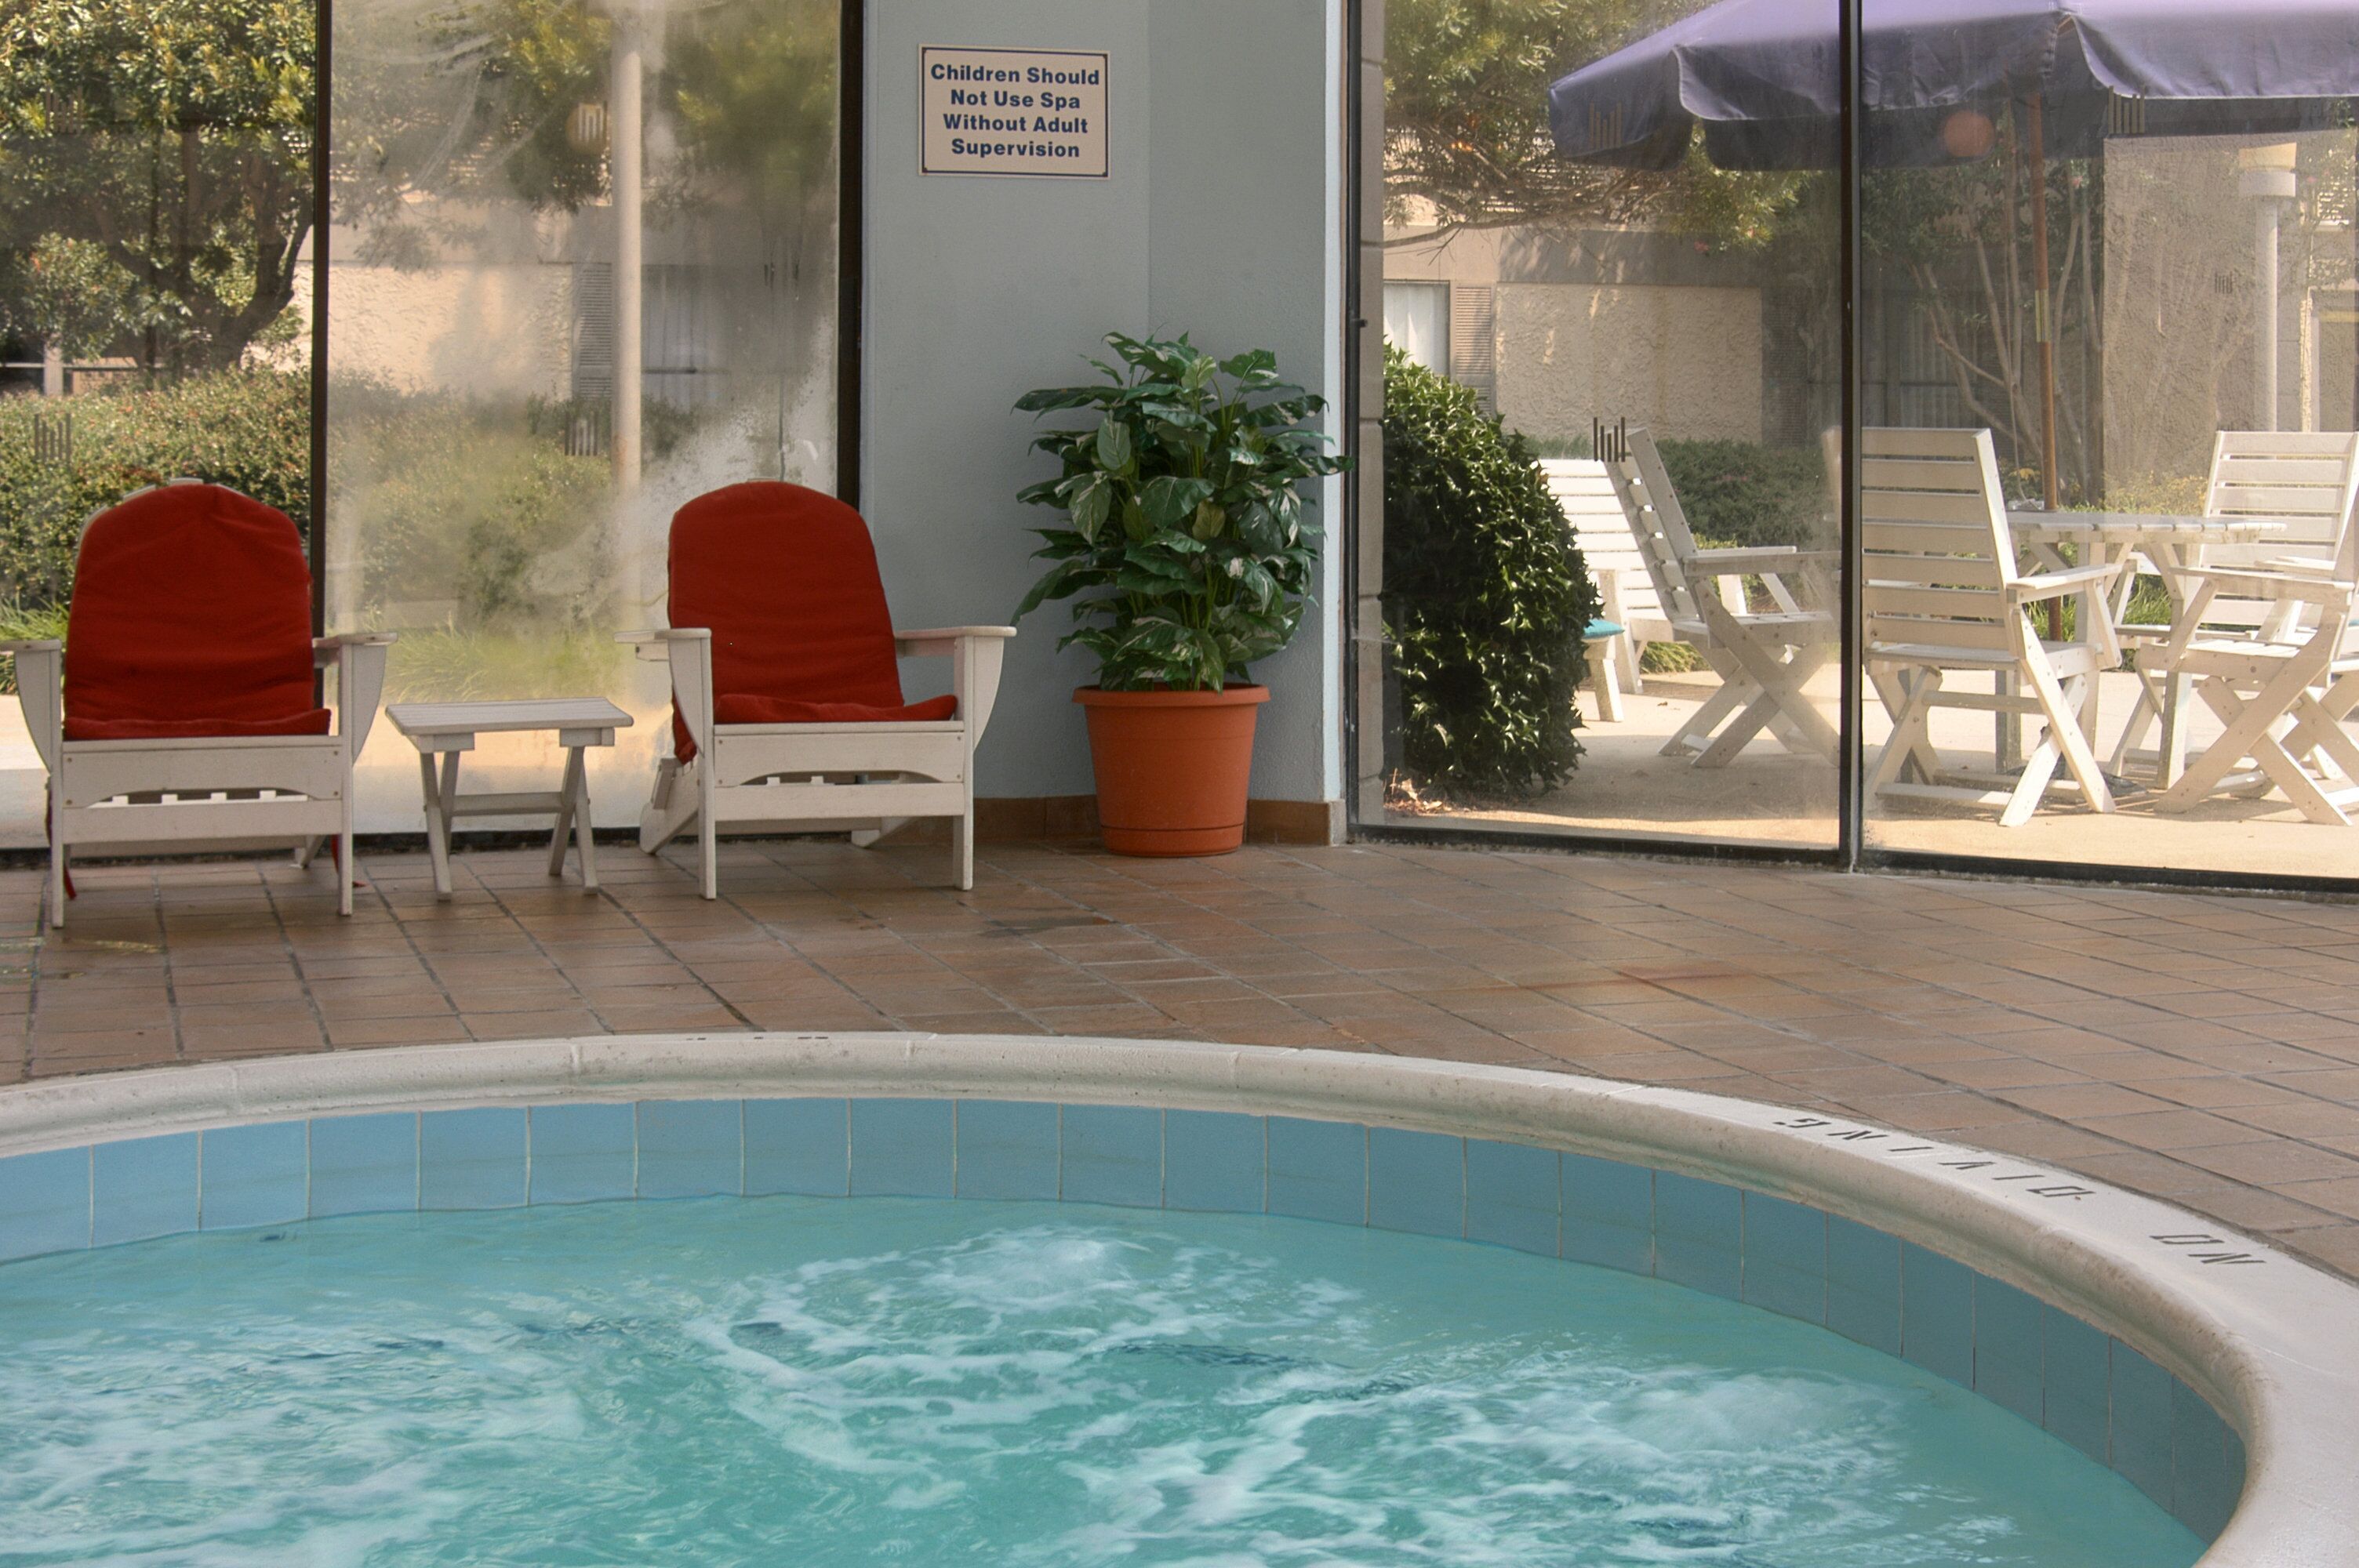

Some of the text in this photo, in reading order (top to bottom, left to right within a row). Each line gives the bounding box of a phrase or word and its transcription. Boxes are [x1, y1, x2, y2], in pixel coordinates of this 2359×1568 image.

[930, 64, 1100, 85] Children Should
[951, 89, 1080, 111] Not Use Spa
[943, 113, 1088, 133] Without Adult
[951, 138, 1080, 158] Supervision
[1772, 1117, 2266, 1265] NO DIVING
